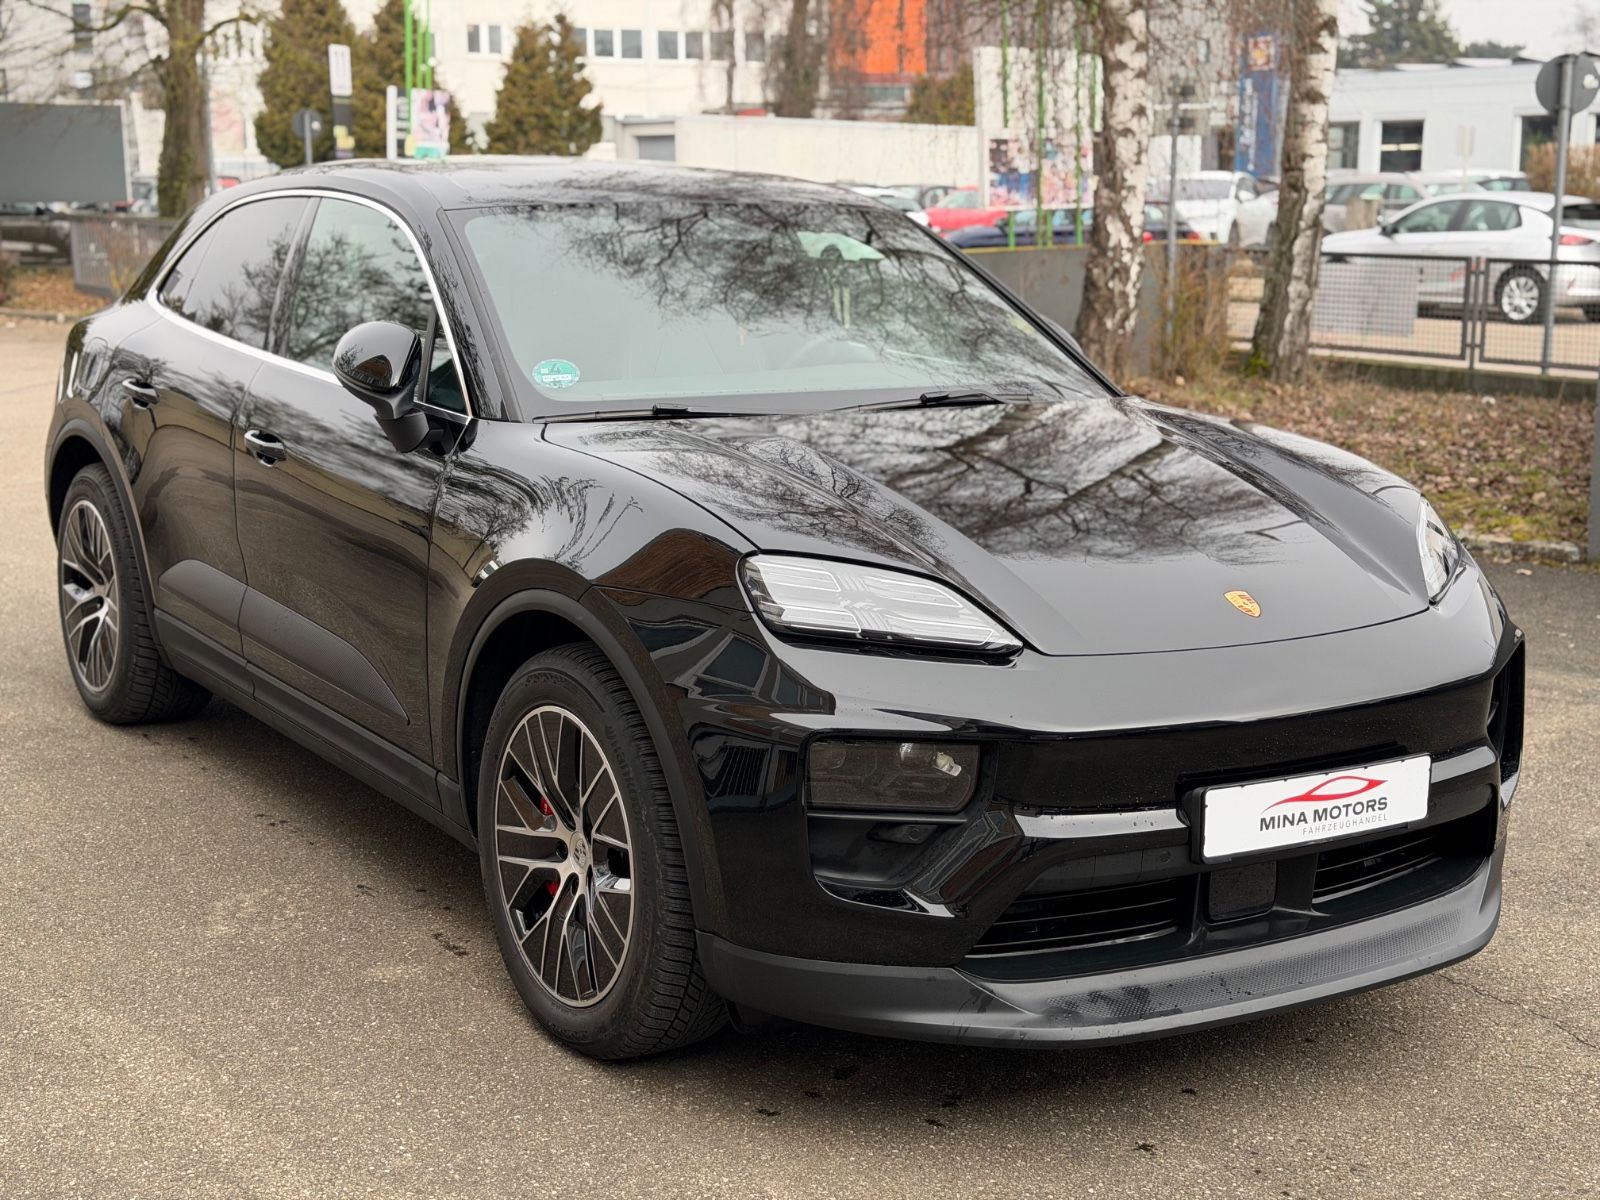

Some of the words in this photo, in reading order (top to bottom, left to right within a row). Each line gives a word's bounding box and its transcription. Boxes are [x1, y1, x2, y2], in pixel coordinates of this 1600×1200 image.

[1259, 811, 1308, 831] MINA
[1313, 797, 1388, 823] MOTORS
[1302, 813, 1388, 836] FAHRZEUGHANDEL
